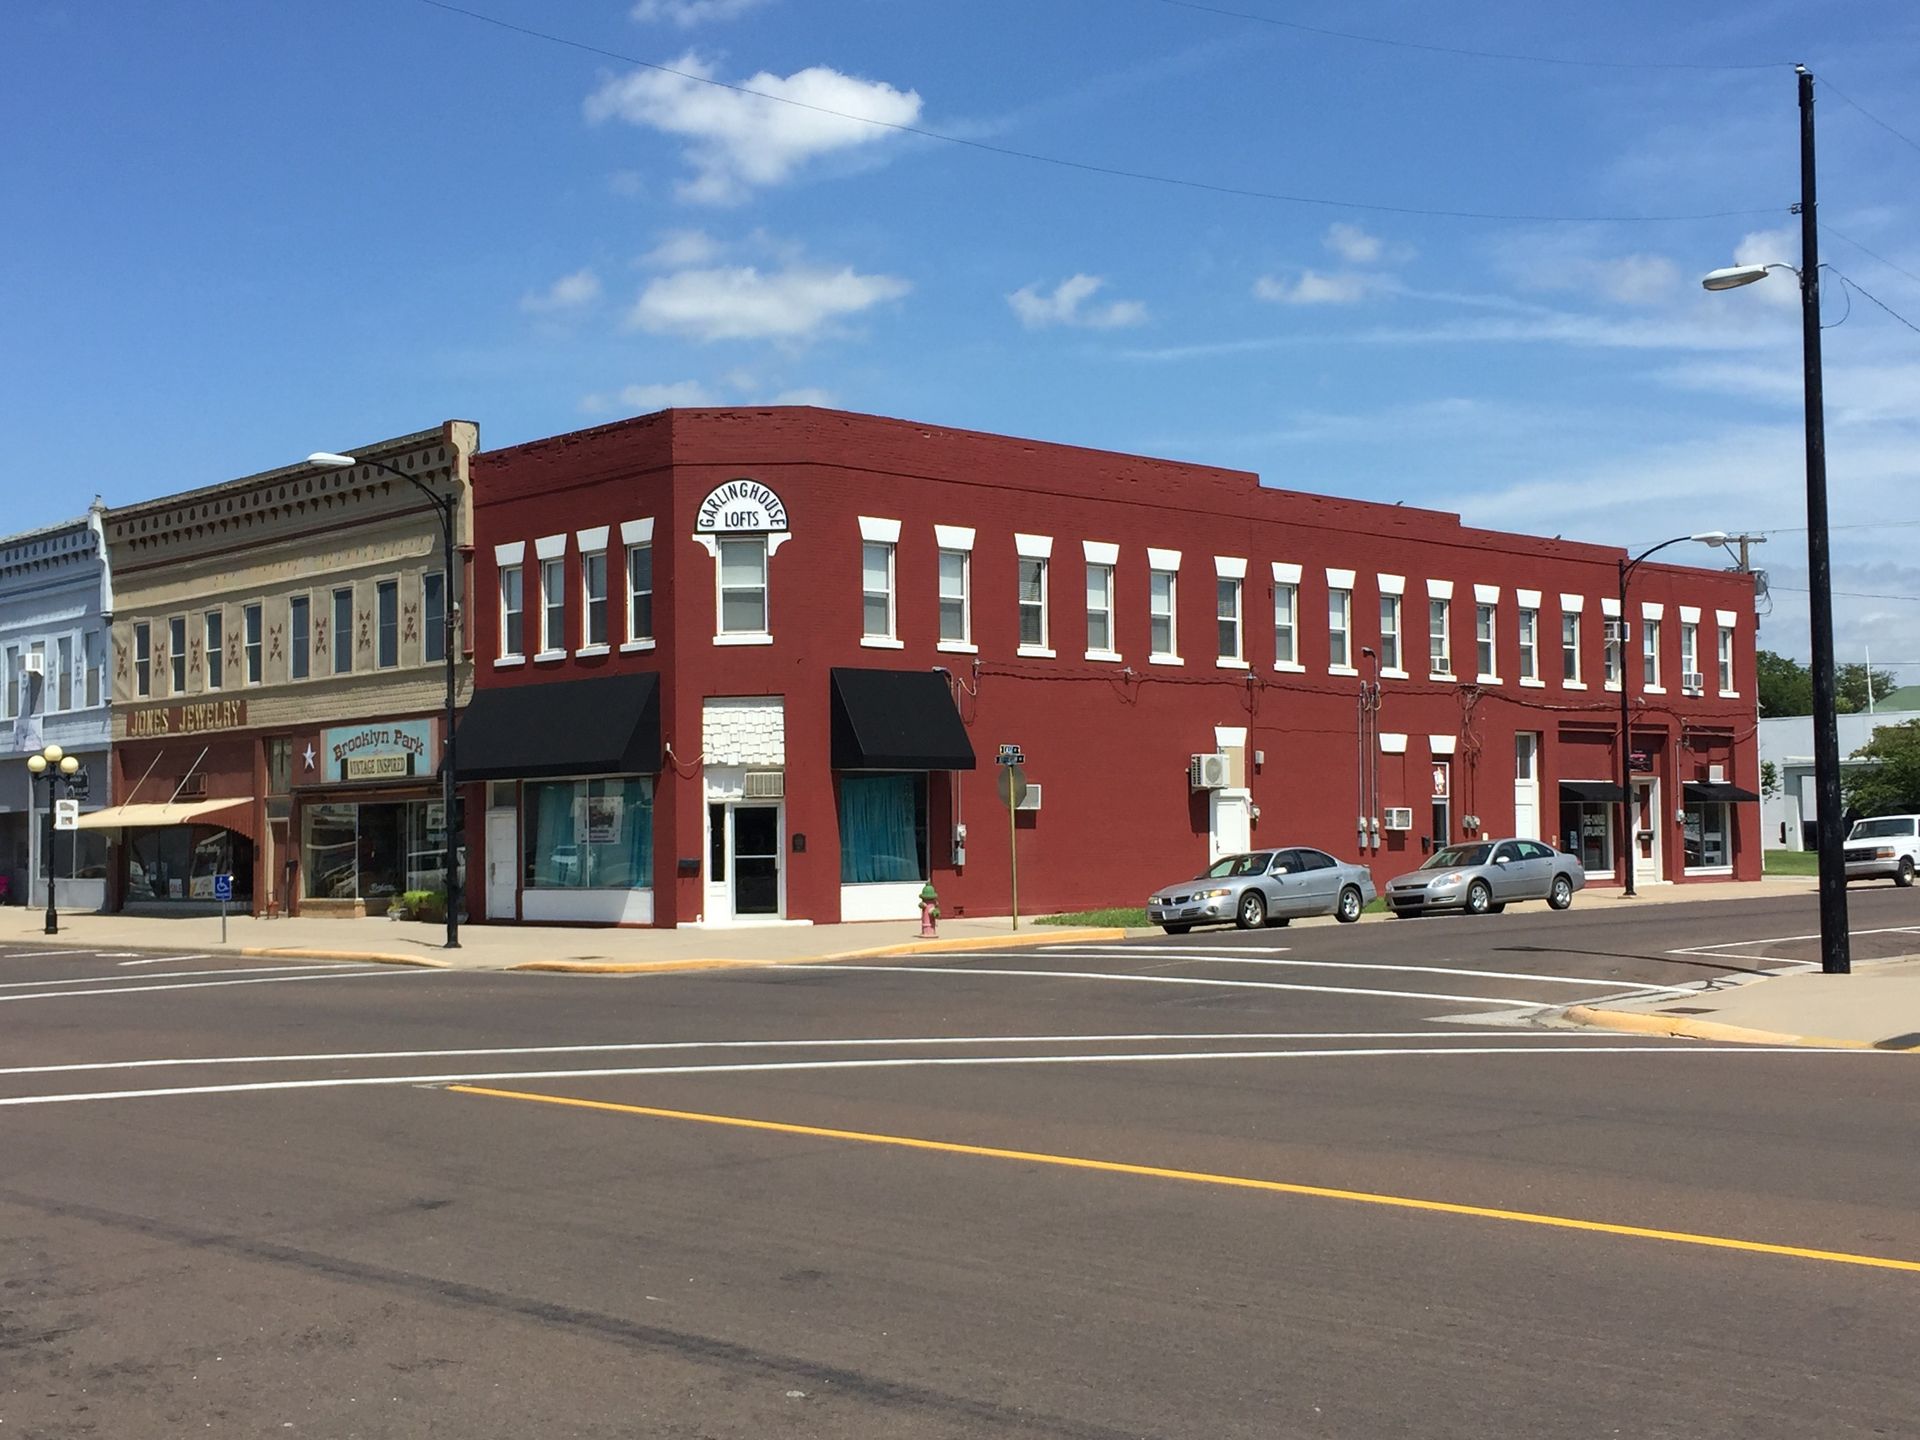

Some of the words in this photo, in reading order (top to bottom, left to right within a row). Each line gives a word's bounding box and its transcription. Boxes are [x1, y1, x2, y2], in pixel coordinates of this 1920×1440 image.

[699, 482, 785, 527] GARLINGHOUSE
[725, 511, 758, 527] LOFTS
[131, 708, 169, 736] JONES
[179, 700, 240, 732] JEWELRY
[333, 729, 389, 762] Brooklyn
[394, 729, 424, 756] Park
[350, 759, 375, 775] VINTAGE
[377, 757, 405, 774] INSPIRED
